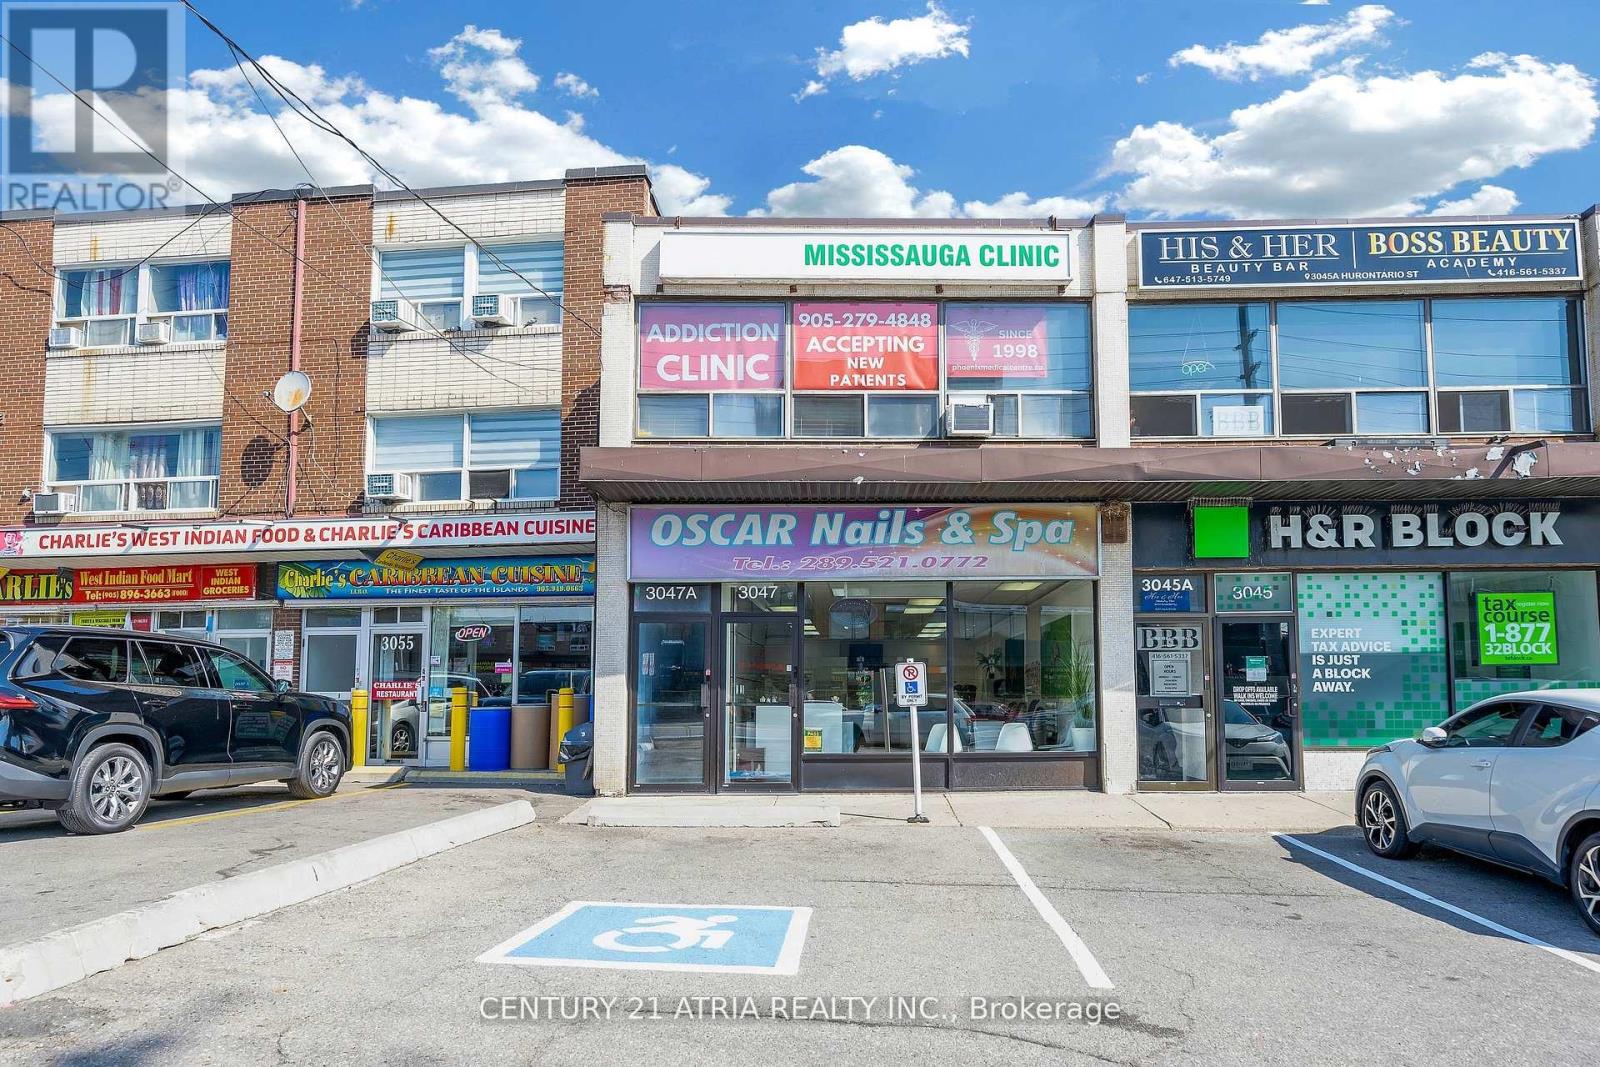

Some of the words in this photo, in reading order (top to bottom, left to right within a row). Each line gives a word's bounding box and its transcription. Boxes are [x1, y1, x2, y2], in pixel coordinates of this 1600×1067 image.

[1158, 236, 1219, 260] HIS
[1229, 236, 1253, 259] &
[1261, 233, 1340, 258] HER
[1368, 231, 1444, 255] BOSS
[1451, 228, 1573, 254] BEAUTY
[804, 244, 971, 267] MISSISSAUGA
[979, 245, 1060, 267] CLINIC
[1191, 262, 1263, 273] BEAUTY
[1273, 261, 1309, 272] BAR
[1426, 257, 1517, 269] ACADEMY
[1310, 272, 1340, 280] 3045A
[1341, 271, 1405, 280] HURONTARIO
[1406, 270, 1419, 279] ST
[1497, 267, 1567, 276] 416-561-5337
[1163, 275, 1231, 284] 647-513-5749
[798, 312, 932, 329] 905-279-4848
[646, 322, 779, 343] ADDICTION
[998, 329, 1033, 339] SINCE
[806, 335, 925, 354] ACCEPTING
[993, 344, 1038, 358] 1998
[656, 354, 770, 382] CLINIC
[847, 357, 885, 370] NEW
[830, 373, 906, 388] PATIENTS
[38, 530, 127, 550] CHARLIE'S
[132, 531, 180, 547] WEST
[184, 529, 247, 545] INDIAN
[252, 527, 300, 544] FOOD
[303, 527, 316, 543] &
[319, 523, 414, 542] CHARLIE'S
[417, 520, 519, 539] CARIBBEAN
[524, 518, 595, 536] CUISINE
[651, 513, 798, 546] OSCAR
[809, 508, 926, 546] Nails
[941, 510, 975, 545] &
[988, 510, 1075, 551] Spa
[1269, 513, 1375, 548] H&R
[1392, 511, 1564, 548] BLOCK
[800, 555, 989, 571] 289.521.0772
[80, 570, 103, 586] West
[104, 570, 138, 586] Indian
[140, 568, 165, 585] Food
[166, 568, 193, 584] Mart
[215, 568, 239, 577] WEST
[284, 568, 347, 588] Charlie's
[350, 566, 487, 586] CARIBBEAN
[490, 564, 583, 585] CUISINE
[211, 576, 241, 586] INDIAN
[1141, 578, 1194, 591] 3045A
[120, 589, 171, 599] 896-3663
[203, 585, 249, 595] GROCERIES
[645, 586, 697, 600] 3047A
[737, 585, 778, 600] 3047
[1232, 586, 1273, 600] 3045
[1483, 596, 1517, 611] tax
[1483, 610, 1550, 623] course
[458, 627, 487, 639] OPEN
[1141, 628, 1199, 649] BBB
[1311, 628, 1362, 638] EXPERT
[1484, 623, 1551, 643] 1-877
[381, 635, 414, 651] 3055
[1311, 641, 1340, 652] TAX
[1341, 641, 1392, 652] ADVICE
[1485, 642, 1552, 655] 32BLOCK
[1312, 655, 1325, 666] IS
[1327, 655, 1360, 666] JUST
[1312, 668, 1323, 679] A
[1325, 668, 1371, 679] BLOCK
[373, 681, 421, 689] CHARLIE'S
[1312, 681, 1355, 693] AWAY.
[376, 689, 418, 698] RESTAURANT
